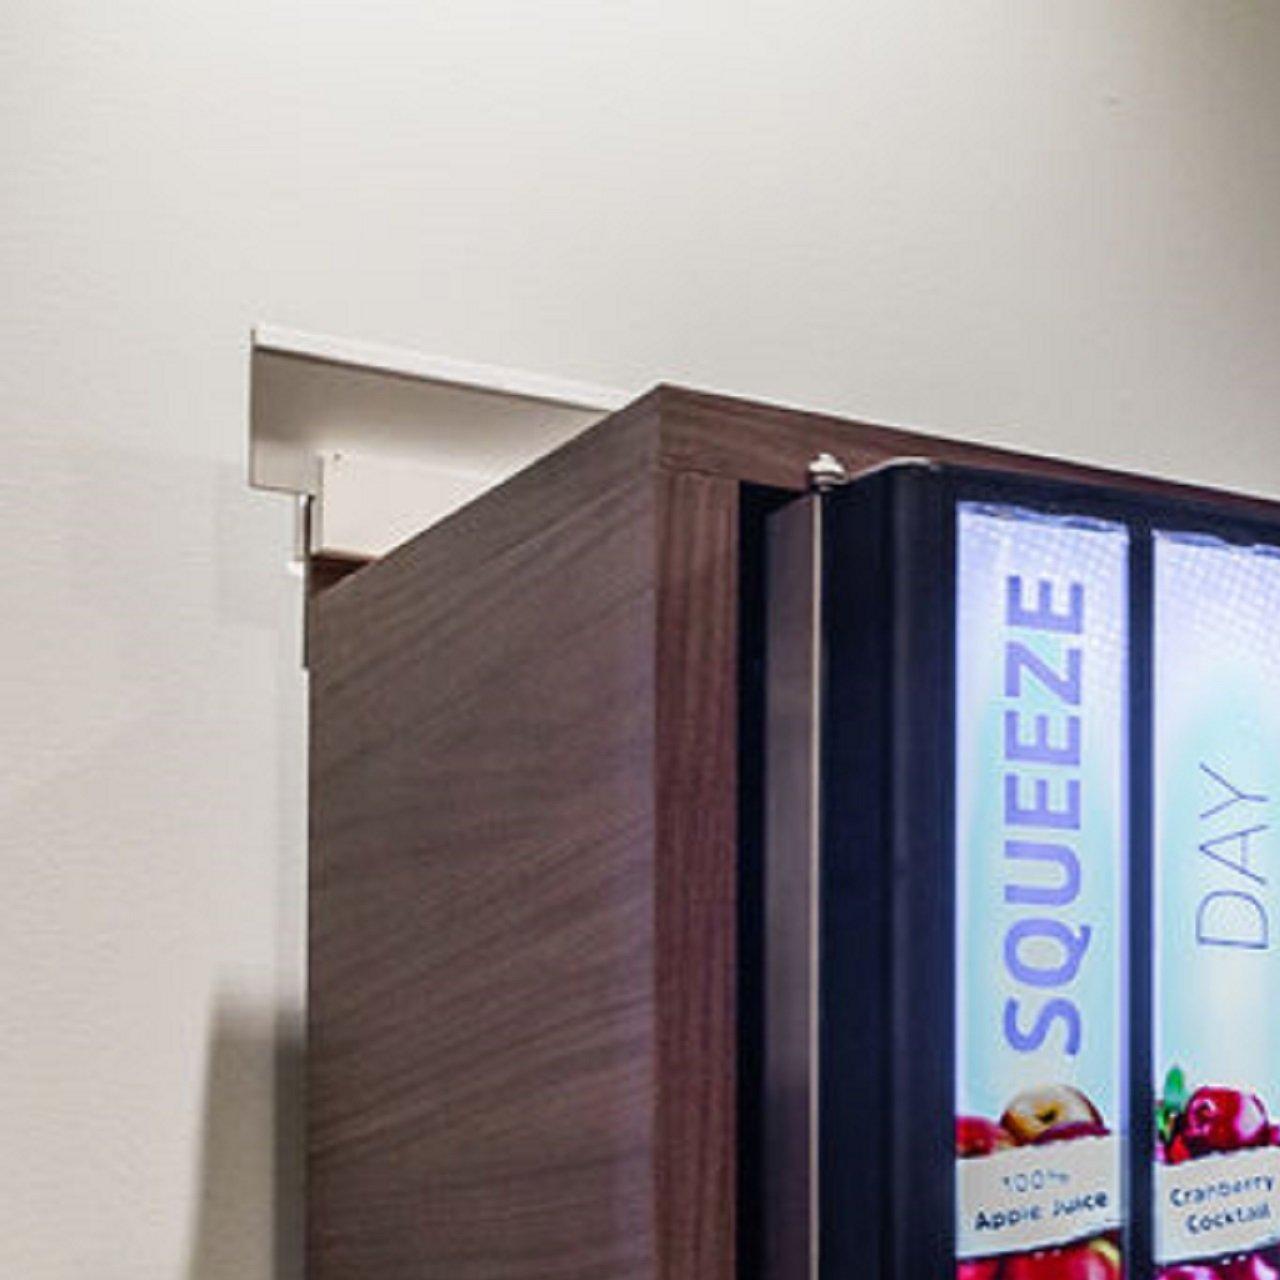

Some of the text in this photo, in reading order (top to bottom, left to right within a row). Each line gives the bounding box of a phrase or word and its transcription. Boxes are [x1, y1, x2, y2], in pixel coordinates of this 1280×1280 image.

[1004, 574, 1093, 1055] SQUEEZE
[1195, 763, 1270, 950] DAY
[974, 1190, 1109, 1231] Apple Juice
[1169, 1174, 1276, 1208] Cranberry
[1185, 1201, 1271, 1234] Cocktail
